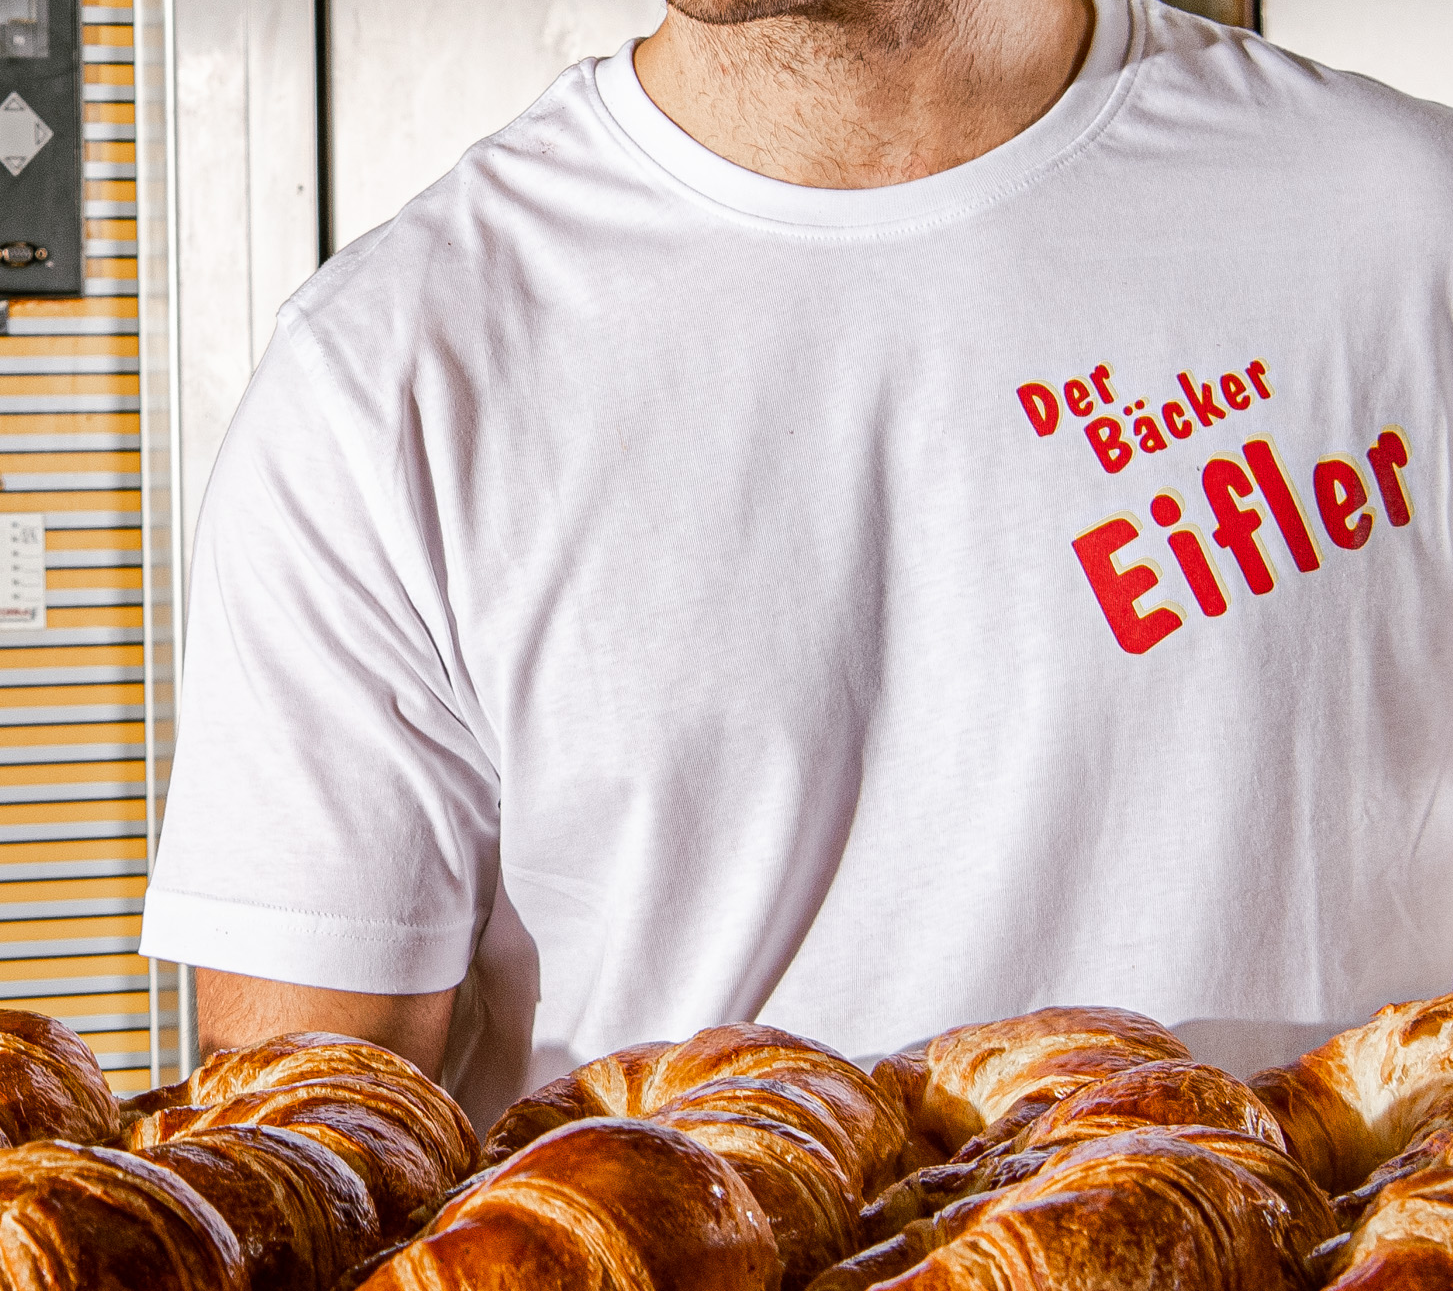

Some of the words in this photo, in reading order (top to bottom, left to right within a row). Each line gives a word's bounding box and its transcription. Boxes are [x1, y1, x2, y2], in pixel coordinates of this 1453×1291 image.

[1015, 360, 1118, 438] Der
[1083, 356, 1277, 475] Bäcker
[1070, 424, 1417, 656] Eifler
